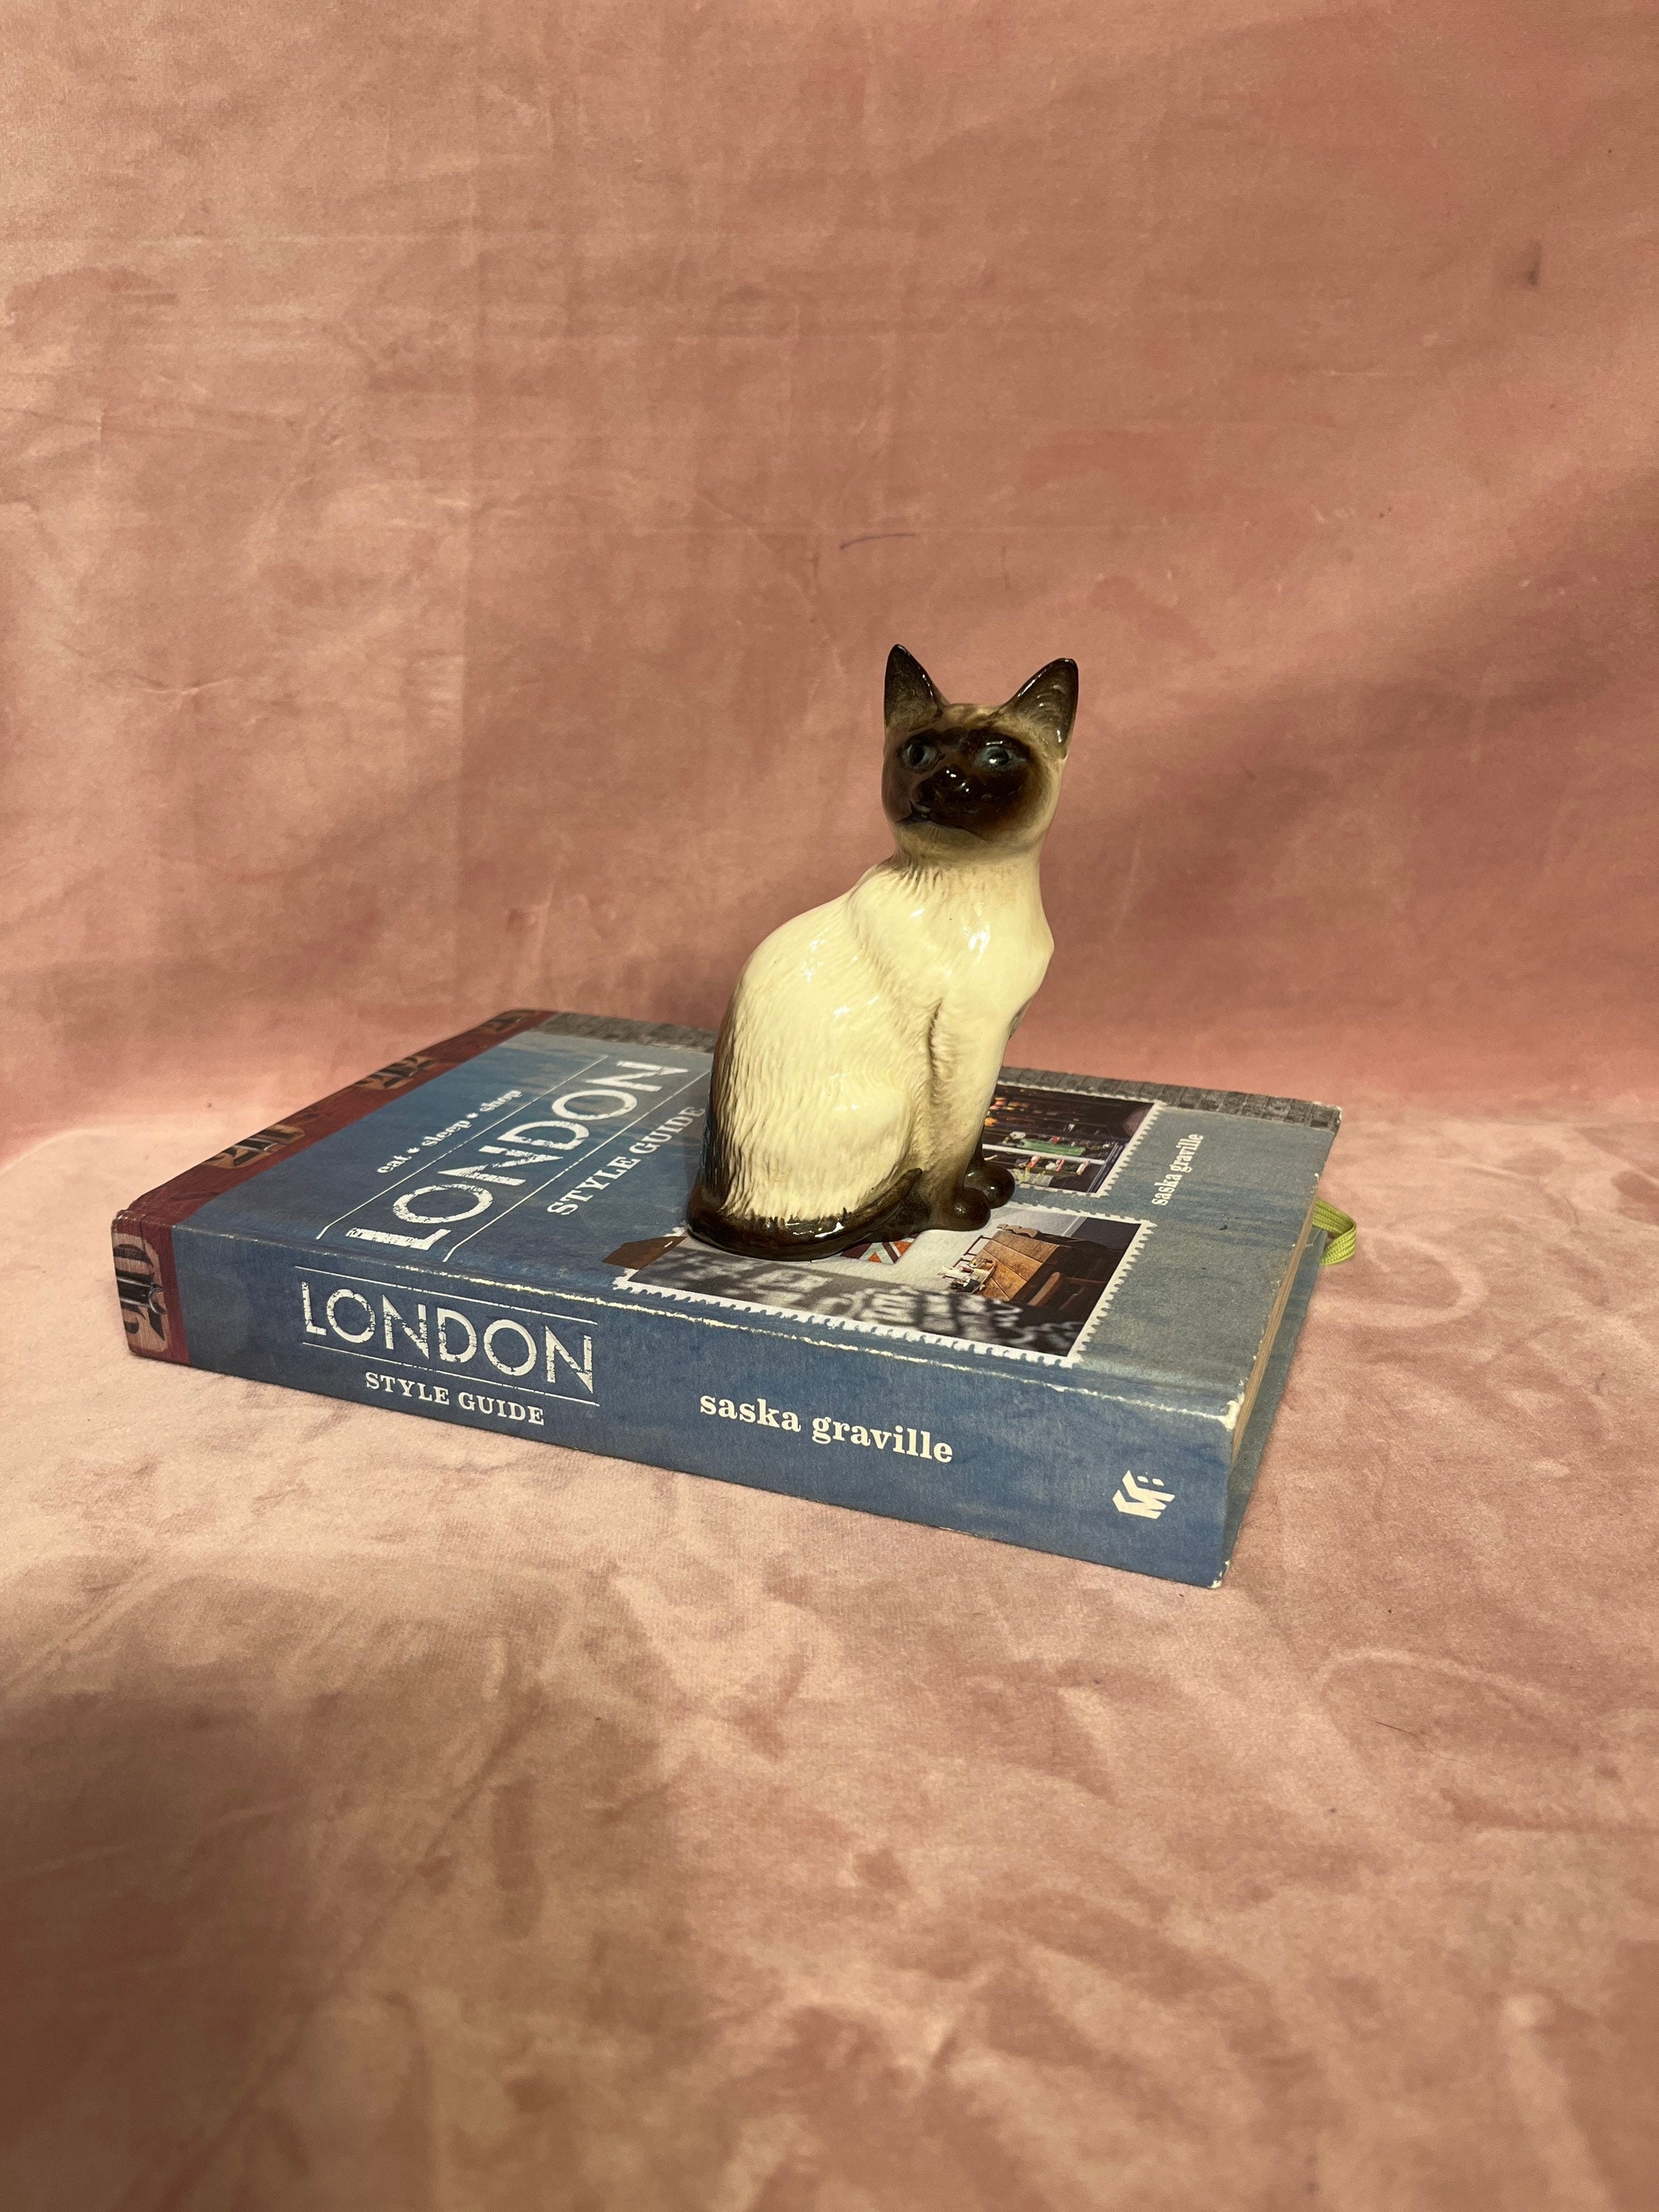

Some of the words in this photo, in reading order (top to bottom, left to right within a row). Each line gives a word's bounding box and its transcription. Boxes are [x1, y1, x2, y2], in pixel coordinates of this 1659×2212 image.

[345, 1060, 689, 1251] LONDON
[377, 1154, 413, 1174] eat
[421, 1119, 473, 1147] sleep
[479, 1089, 523, 1112] shop
[546, 1155, 642, 1216] STYLE
[629, 1106, 706, 1155] GUIDE
[1151, 1173, 1183, 1206] saska
[1169, 1133, 1204, 1173] graville
[301, 1281, 594, 1394] LONDON
[365, 1371, 451, 1405] STYLE
[457, 1391, 546, 1426] GUIDE
[699, 1393, 802, 1433] saska
[810, 1416, 954, 1464] graville
